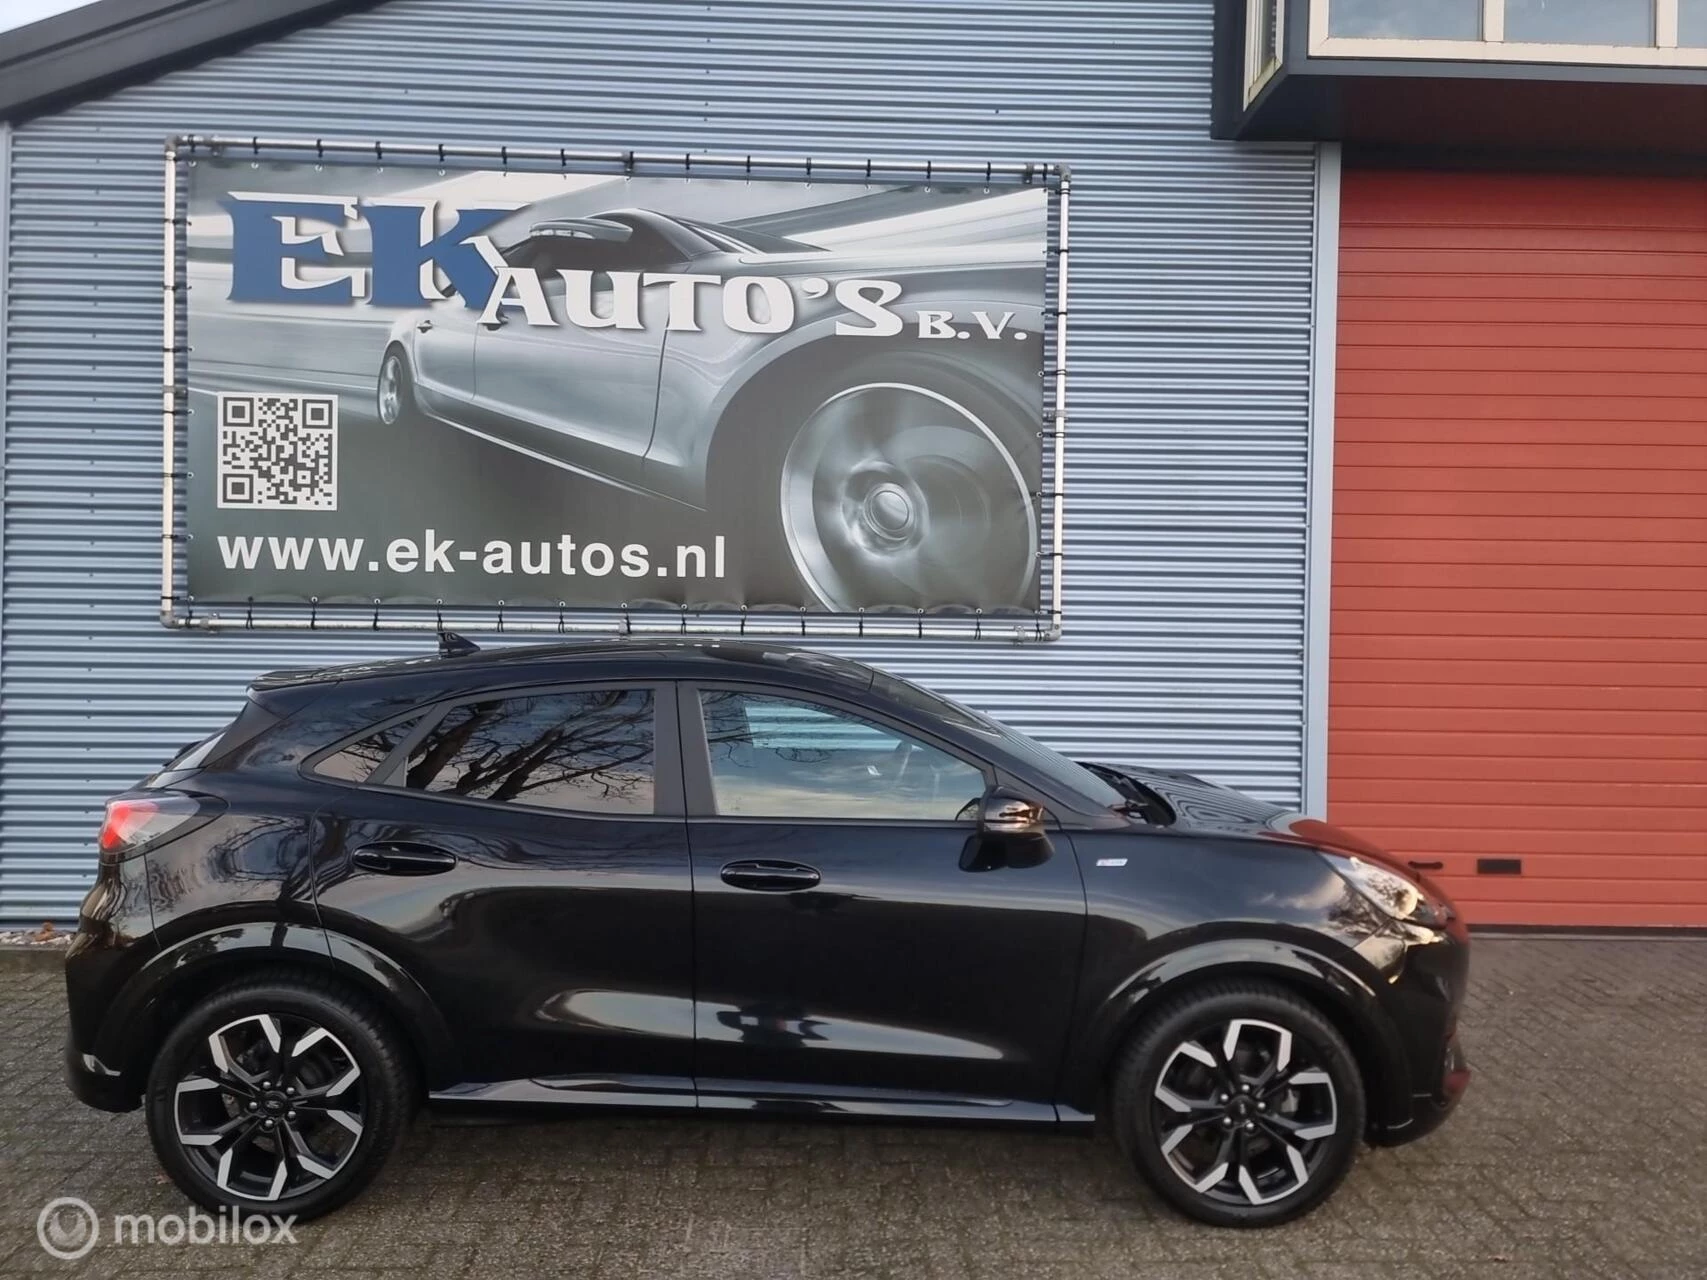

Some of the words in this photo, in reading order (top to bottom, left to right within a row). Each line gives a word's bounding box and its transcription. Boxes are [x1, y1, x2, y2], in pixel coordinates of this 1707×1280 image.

[225, 191, 533, 309] EK
[475, 266, 904, 337] AUTO'S
[917, 310, 1028, 340] B.V.
[217, 529, 725, 578] www.ek-autos.nl
